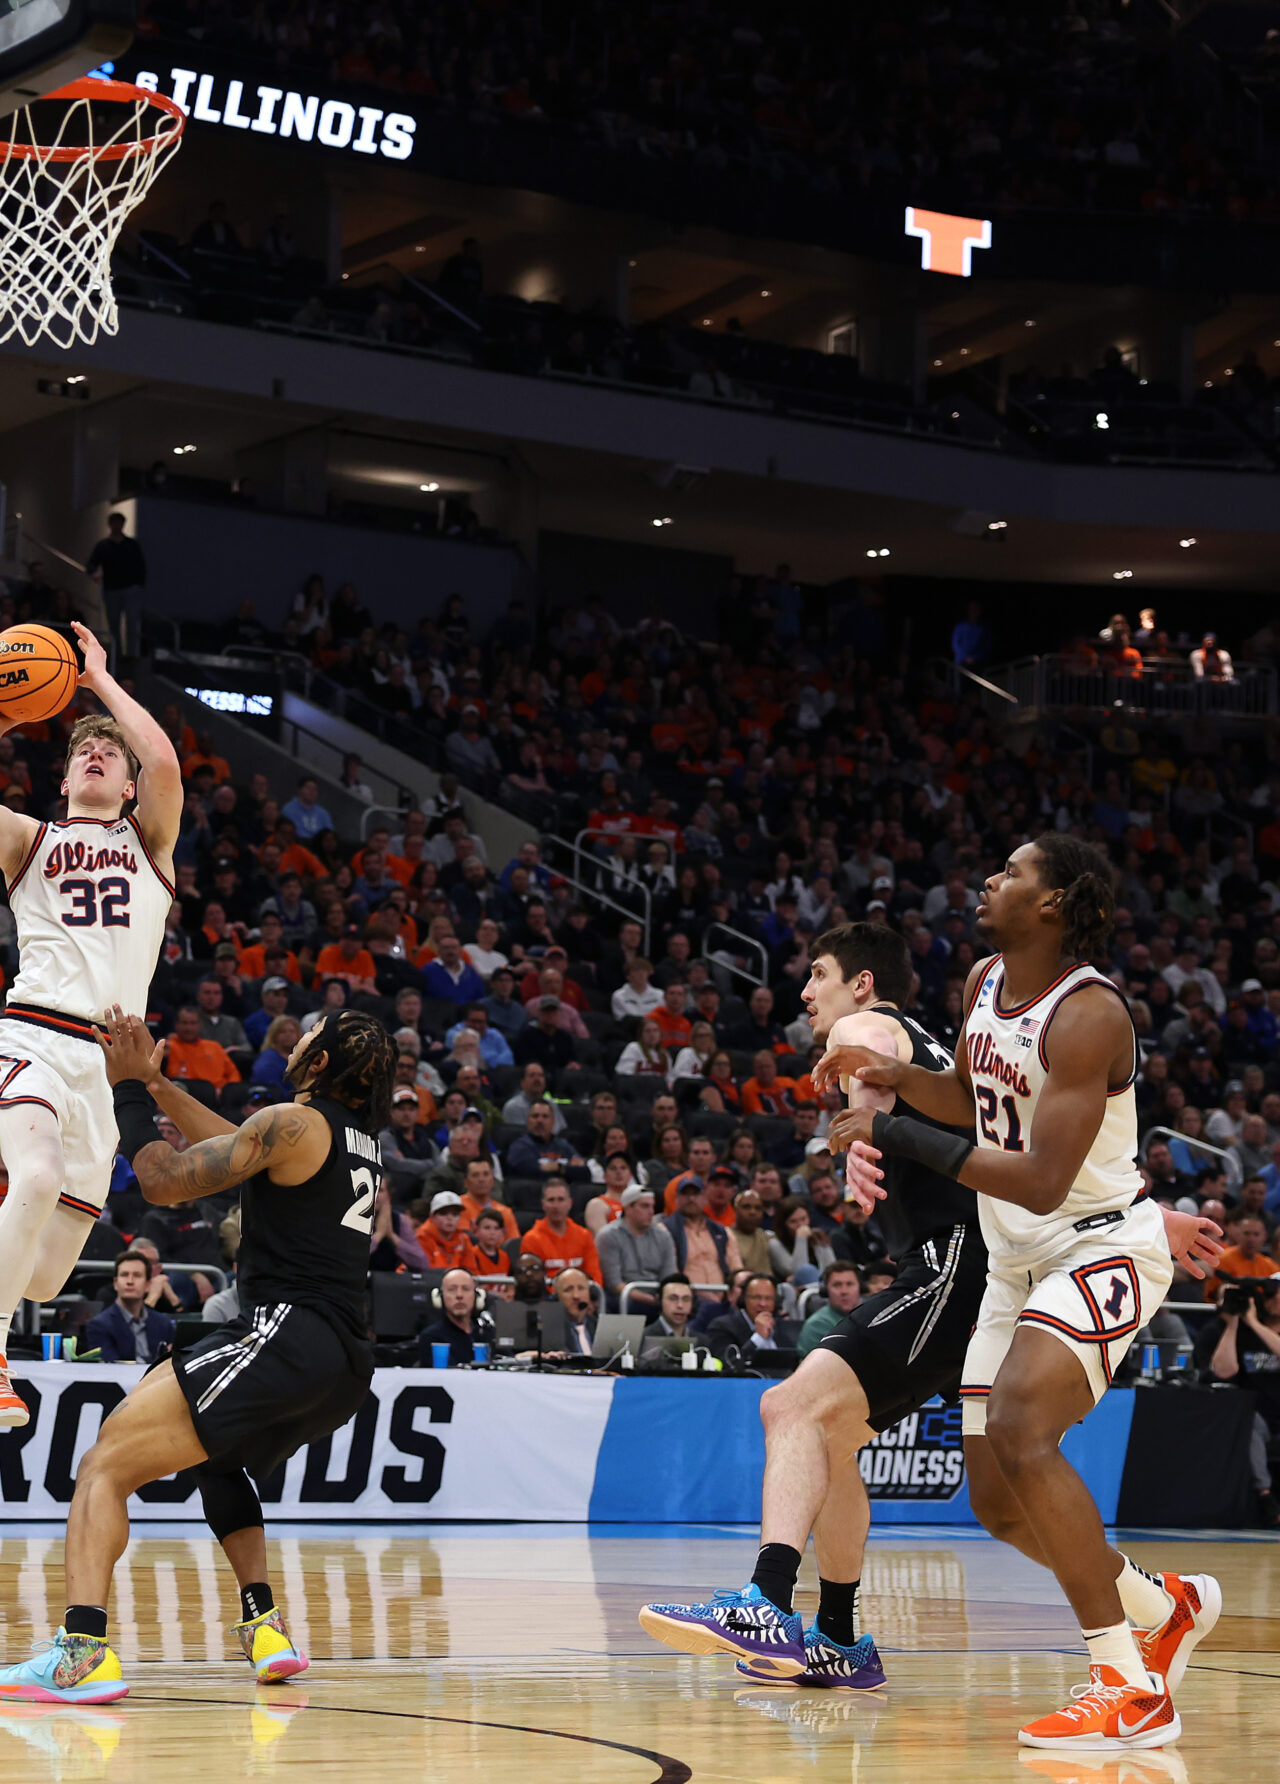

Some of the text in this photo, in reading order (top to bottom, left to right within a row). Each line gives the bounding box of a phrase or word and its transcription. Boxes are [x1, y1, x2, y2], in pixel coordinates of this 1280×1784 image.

[170, 68, 418, 160] ILLINOIS
[43, 841, 138, 880] Illinois
[59, 876, 130, 928] 32
[976, 1084, 1025, 1153] 21
[340, 1166, 381, 1236] 2
[858, 1449, 964, 1486] ADNESS
